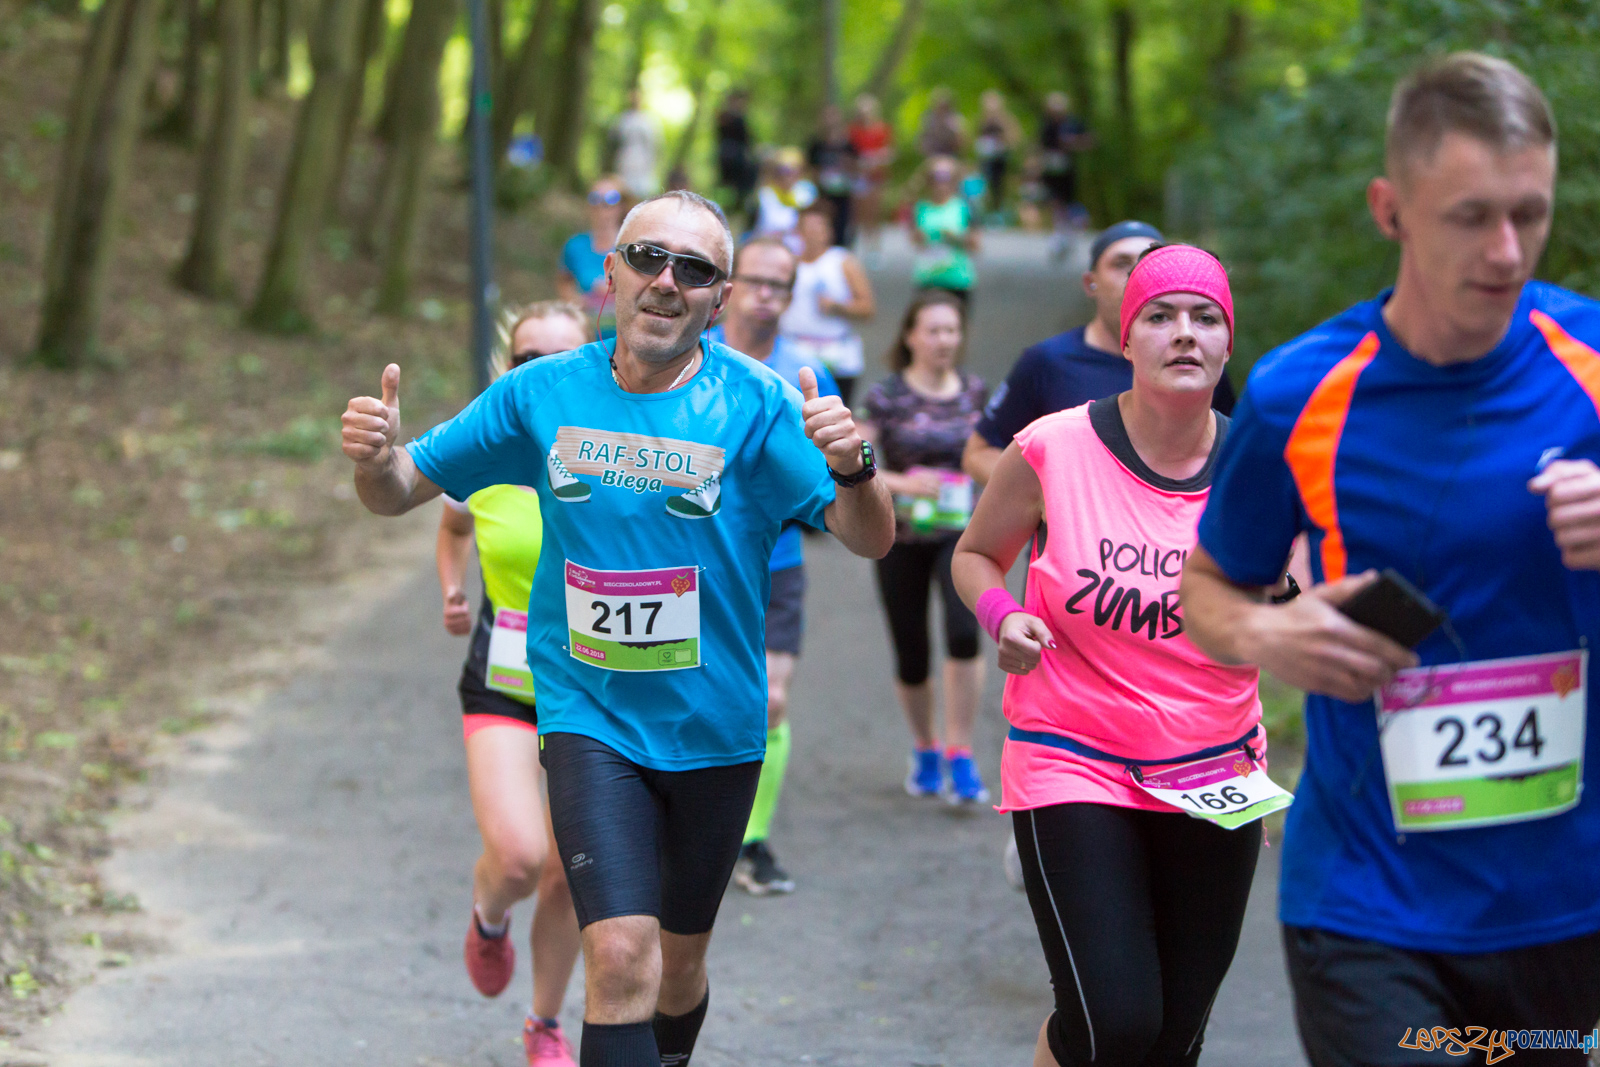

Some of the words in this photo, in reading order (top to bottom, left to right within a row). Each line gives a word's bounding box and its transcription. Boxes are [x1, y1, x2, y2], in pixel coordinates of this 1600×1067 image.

[578, 440, 698, 476] RAF-STOL
[602, 469, 662, 494] Biega
[591, 600, 663, 635] 217
[575, 643, 605, 659] 22.06.2018
[1434, 706, 1545, 768] 234
[1181, 785, 1249, 810] 166
